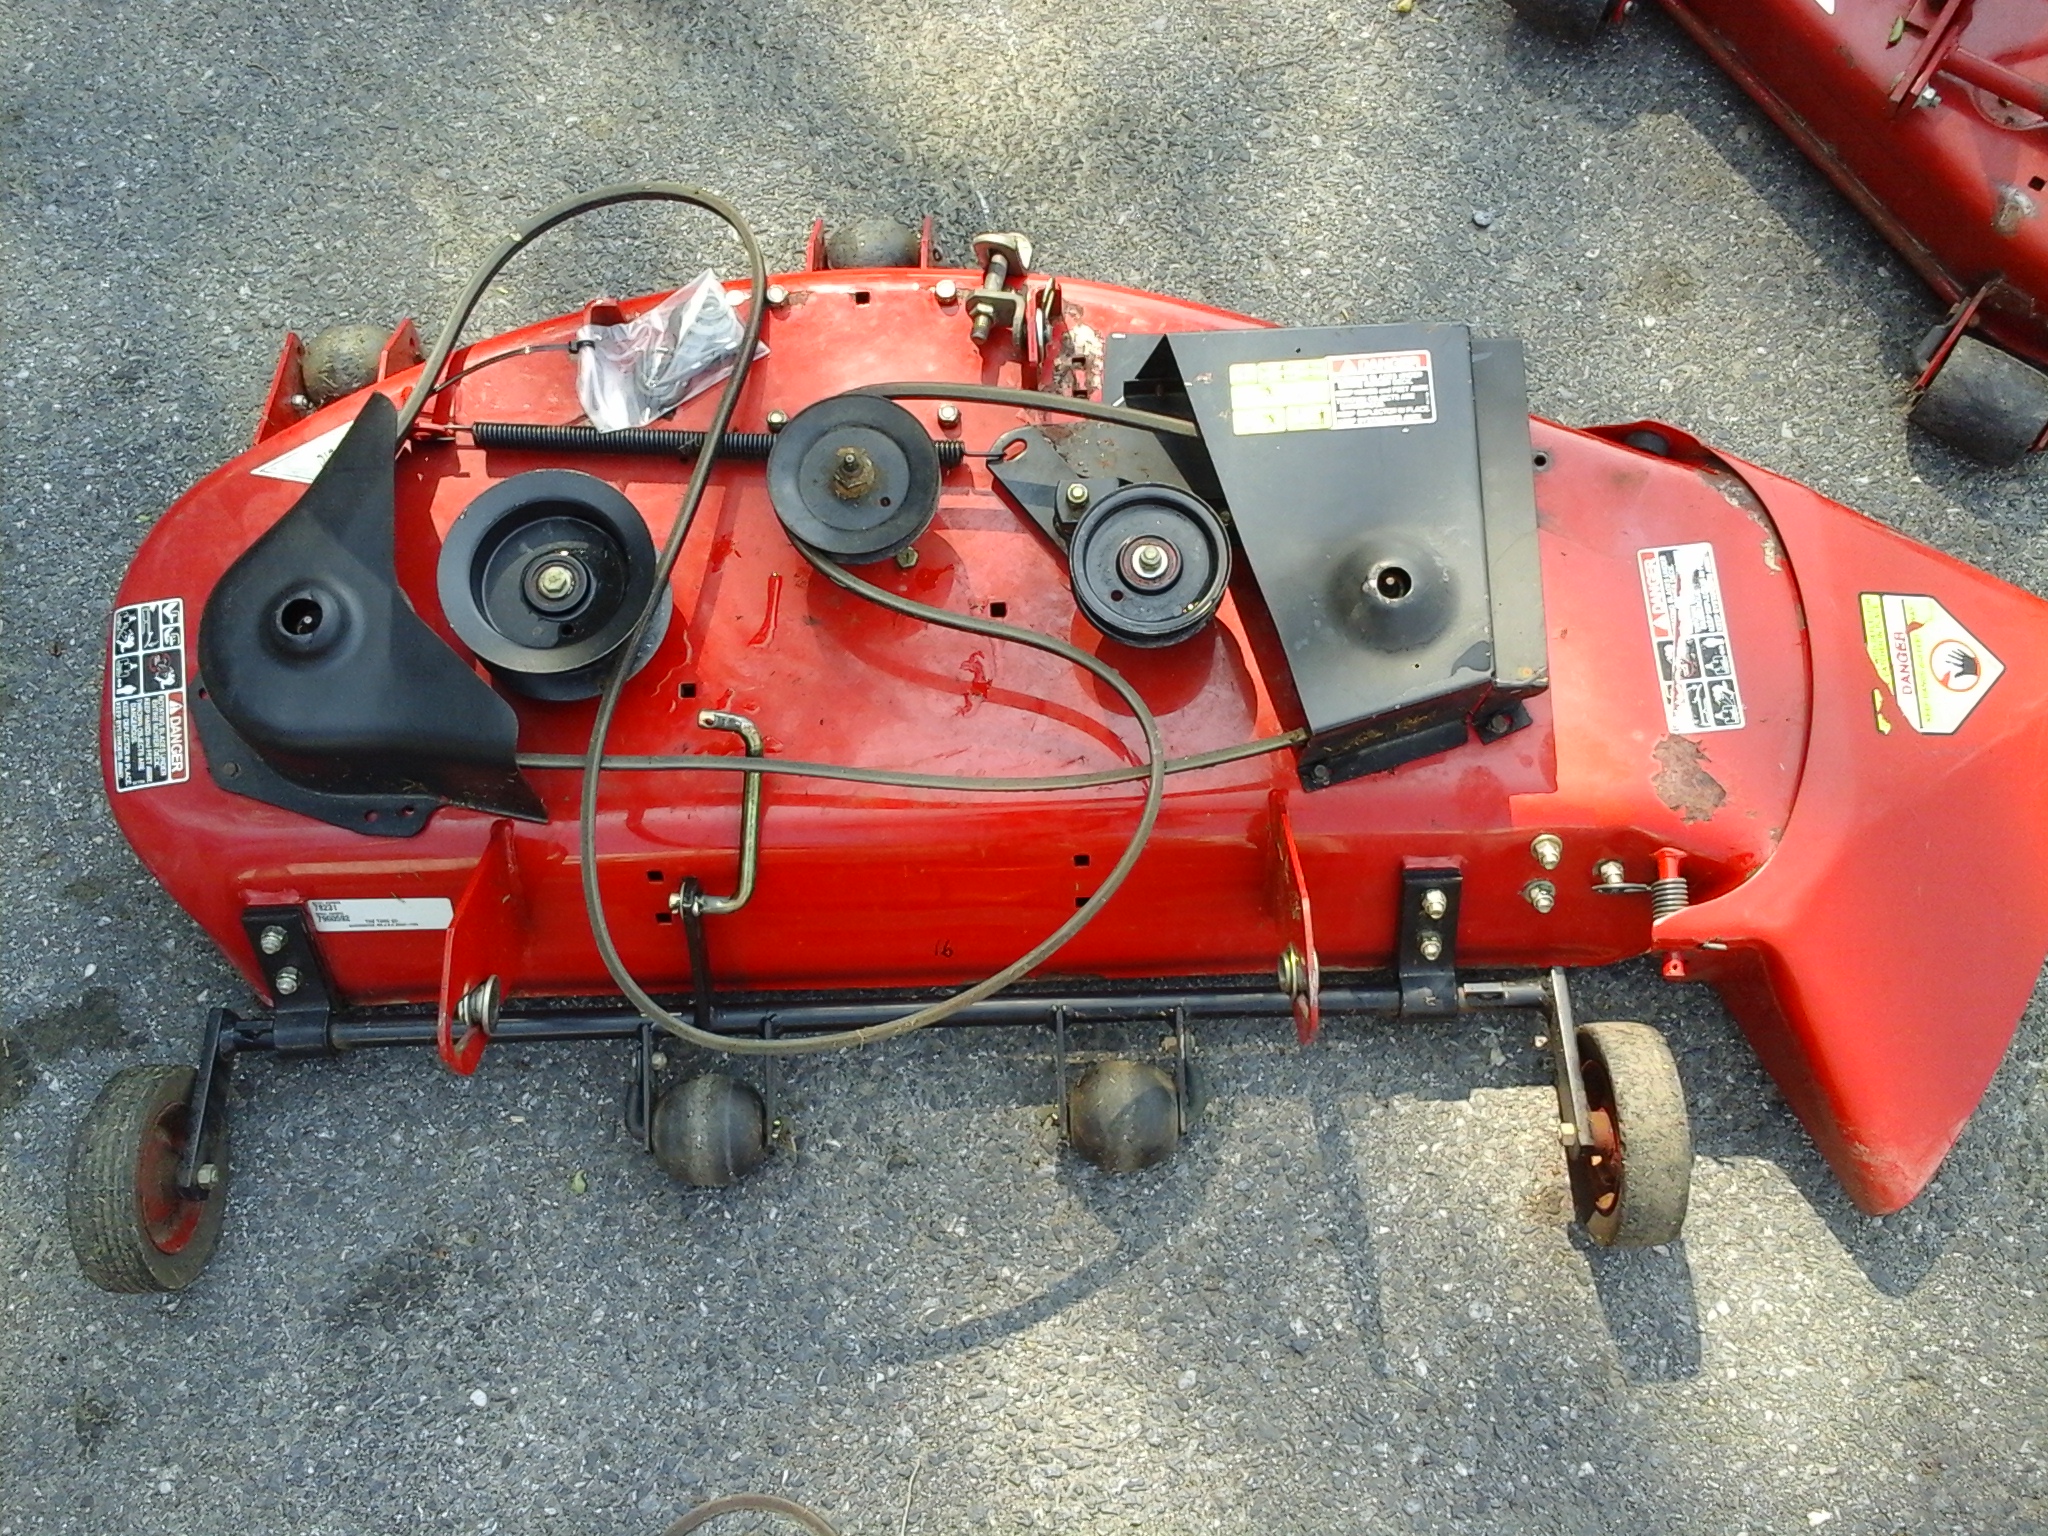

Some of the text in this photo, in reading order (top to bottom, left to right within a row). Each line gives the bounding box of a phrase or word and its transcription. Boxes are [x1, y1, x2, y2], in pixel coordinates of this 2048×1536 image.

[1644, 559, 1666, 613] DANGER
[1893, 631, 1913, 695] DANGER
[169, 716, 184, 773] DANGER
